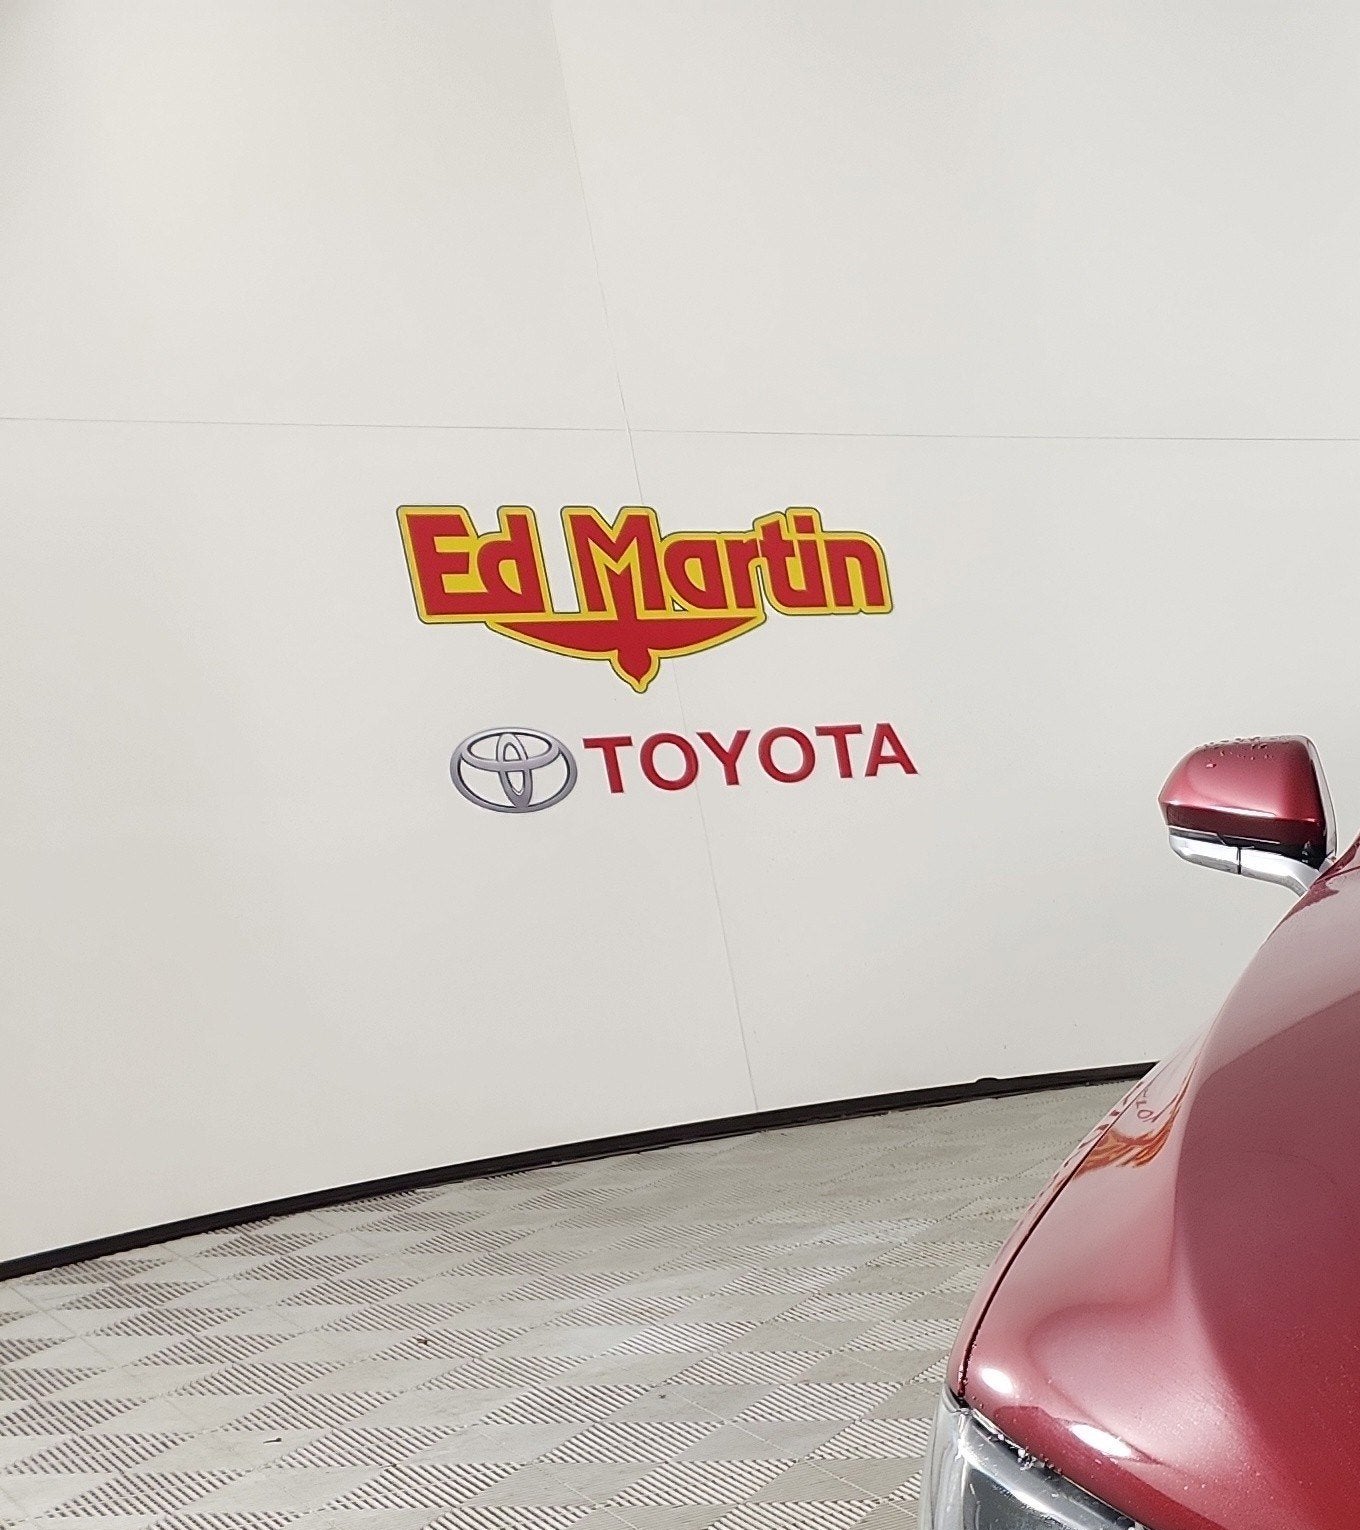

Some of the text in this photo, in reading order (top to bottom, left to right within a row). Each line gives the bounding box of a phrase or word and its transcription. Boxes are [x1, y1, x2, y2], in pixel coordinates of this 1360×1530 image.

[402, 509, 889, 619] Ed Martin
[583, 722, 919, 794] TOYOTA
